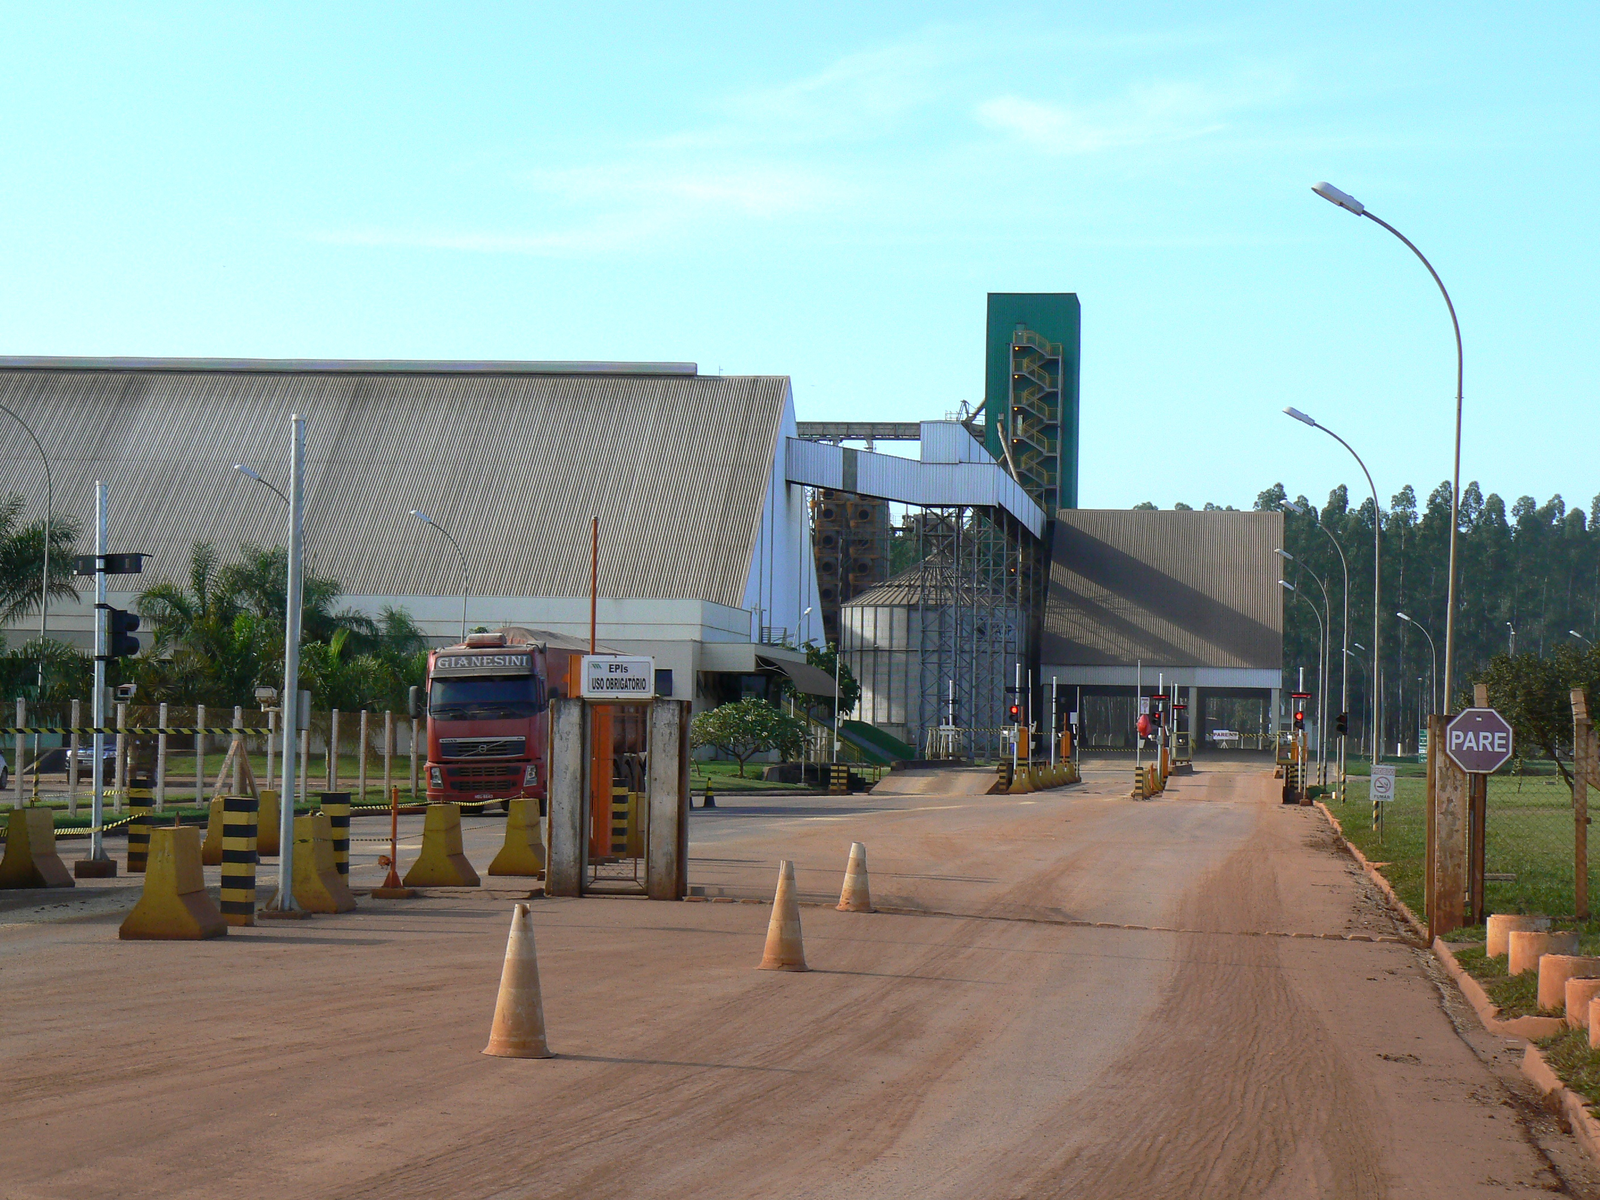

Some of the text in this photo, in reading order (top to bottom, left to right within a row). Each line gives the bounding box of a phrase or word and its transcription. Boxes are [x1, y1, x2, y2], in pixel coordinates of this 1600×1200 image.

[438, 656, 527, 669] GIANESINI
[608, 664, 629, 674] EPIs
[592, 675, 647, 691] USO OBRIGATÓRIO
[1451, 730, 1507, 752] PARE
